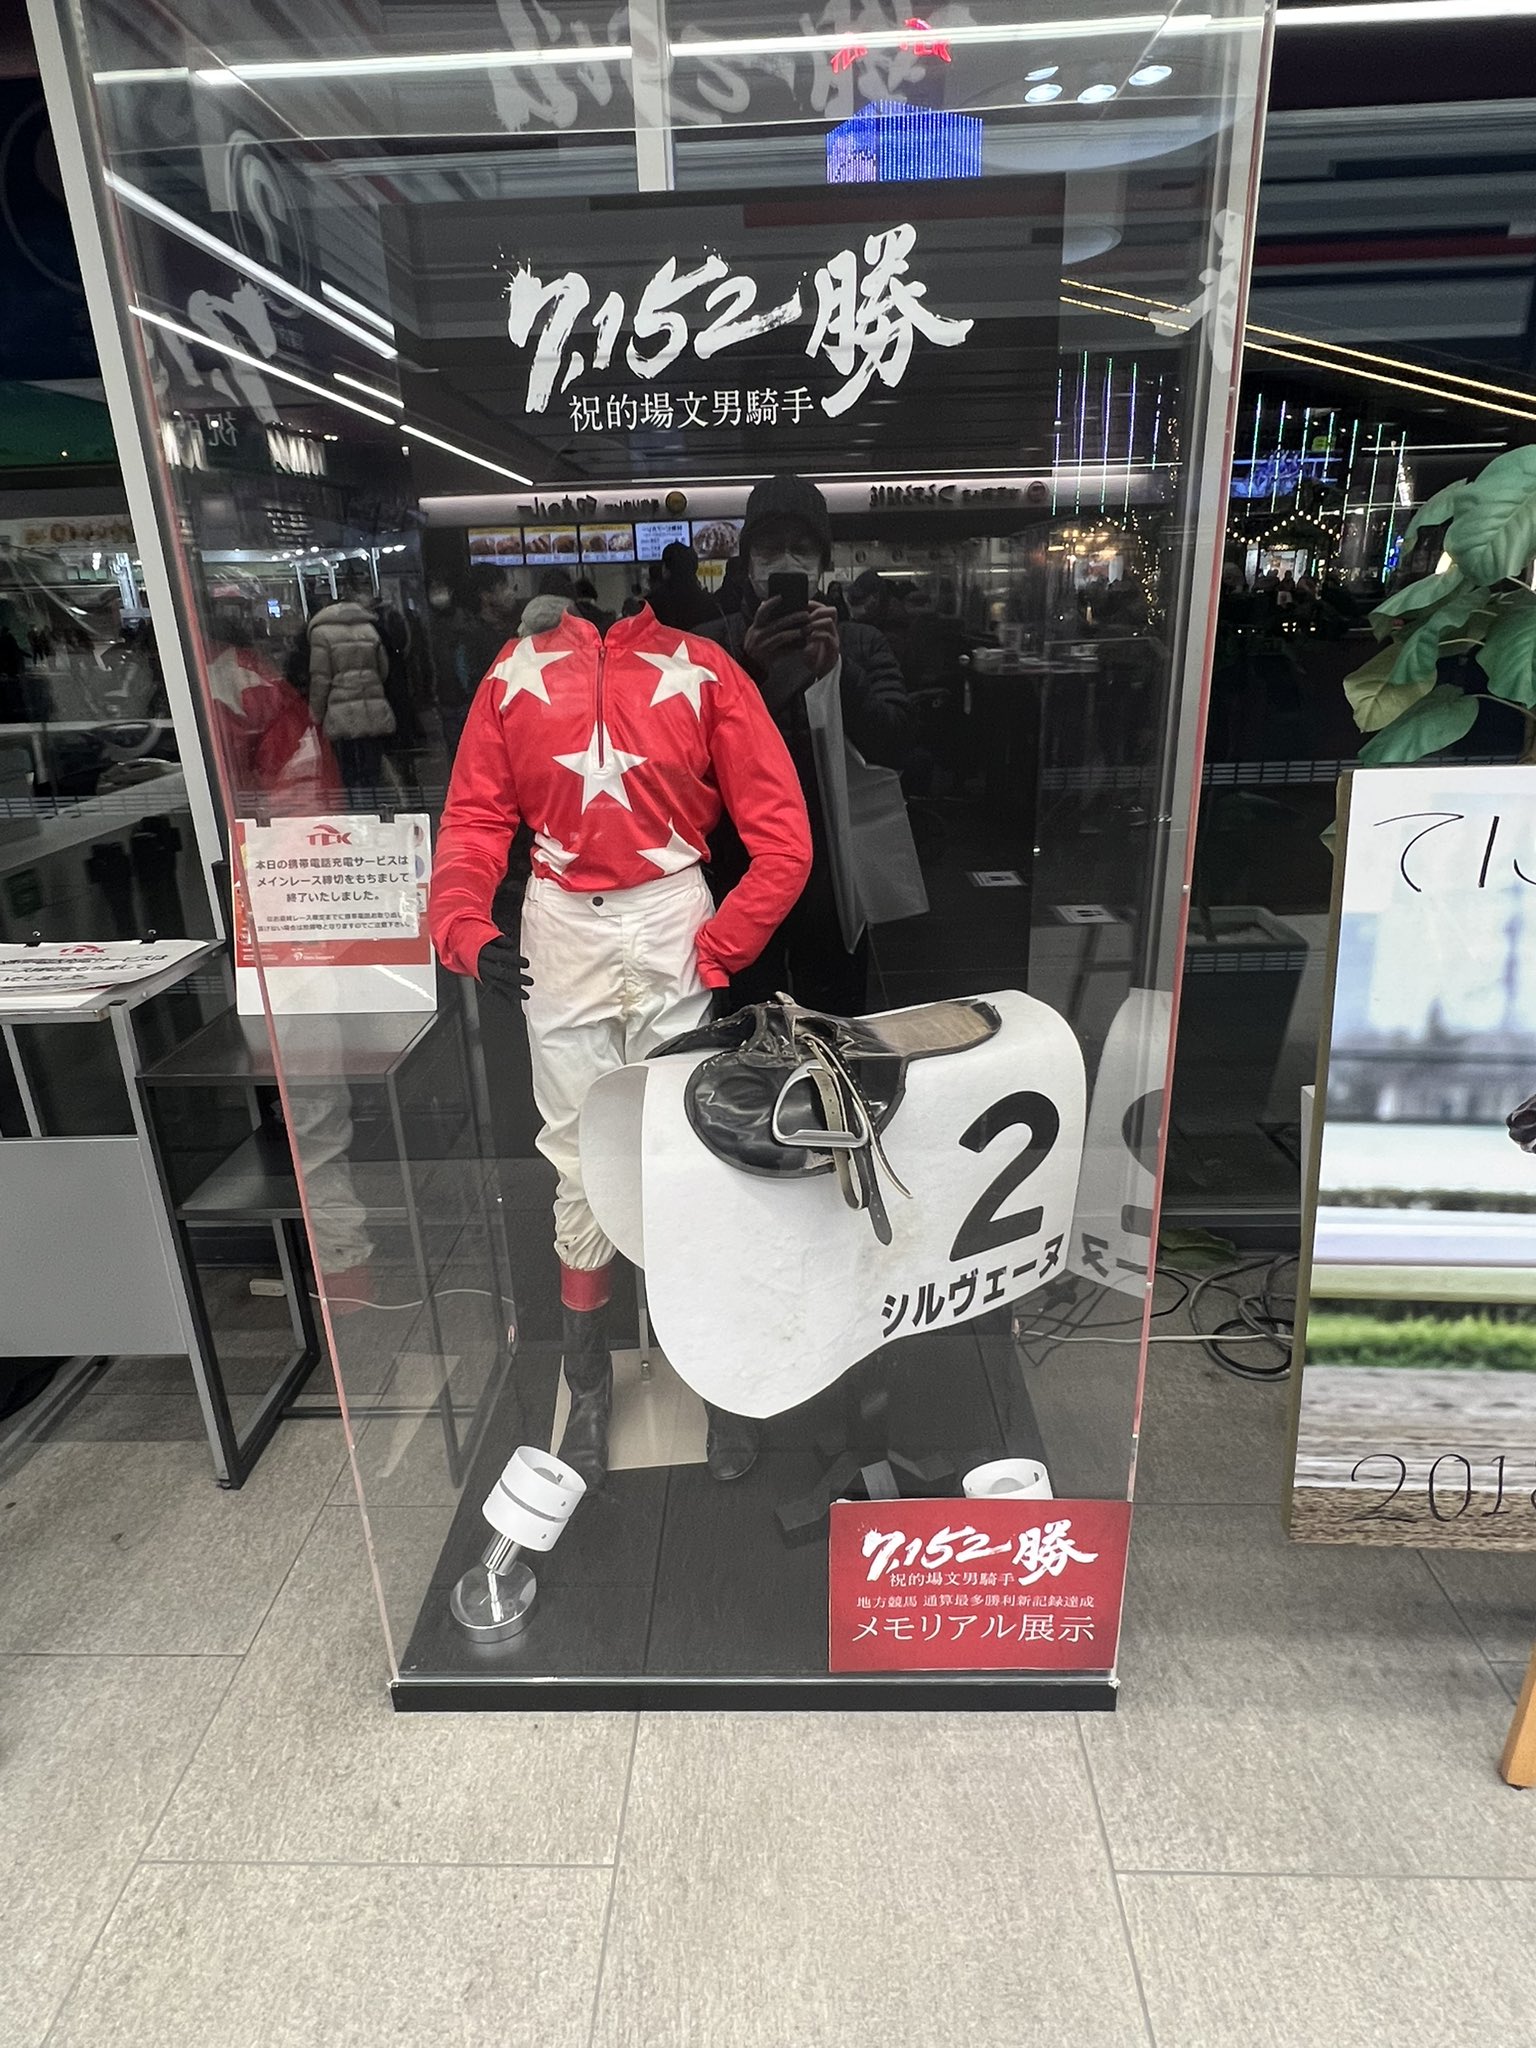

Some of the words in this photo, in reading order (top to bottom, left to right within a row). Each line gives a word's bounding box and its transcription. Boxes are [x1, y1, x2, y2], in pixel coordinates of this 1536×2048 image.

[506, 223, 975, 418] 7,152勝
[568, 386, 815, 433] 祝的場文男騎手
[307, 828, 352, 846] TCK
[255, 854, 409, 870] 本日の携帯電話充電サービスは
[257, 872, 410, 887] メインレース締切をもちまして
[286, 890, 380, 903] 終了いたしました。
[949, 1090, 1060, 1262] 2
[881, 1233, 1065, 1338] シルヴェーヌ
[1346, 1453, 1536, 1524] 201
[860, 1518, 1099, 1586] 7,152勝
[889, 1571, 1015, 1588] 祝的場文男騎手
[857, 1595, 917, 1609] 地方競馬
[923, 1593, 1095, 1609] 通算最多勝利新記録達成
[852, 1612, 1095, 1643] メモリアル展示
